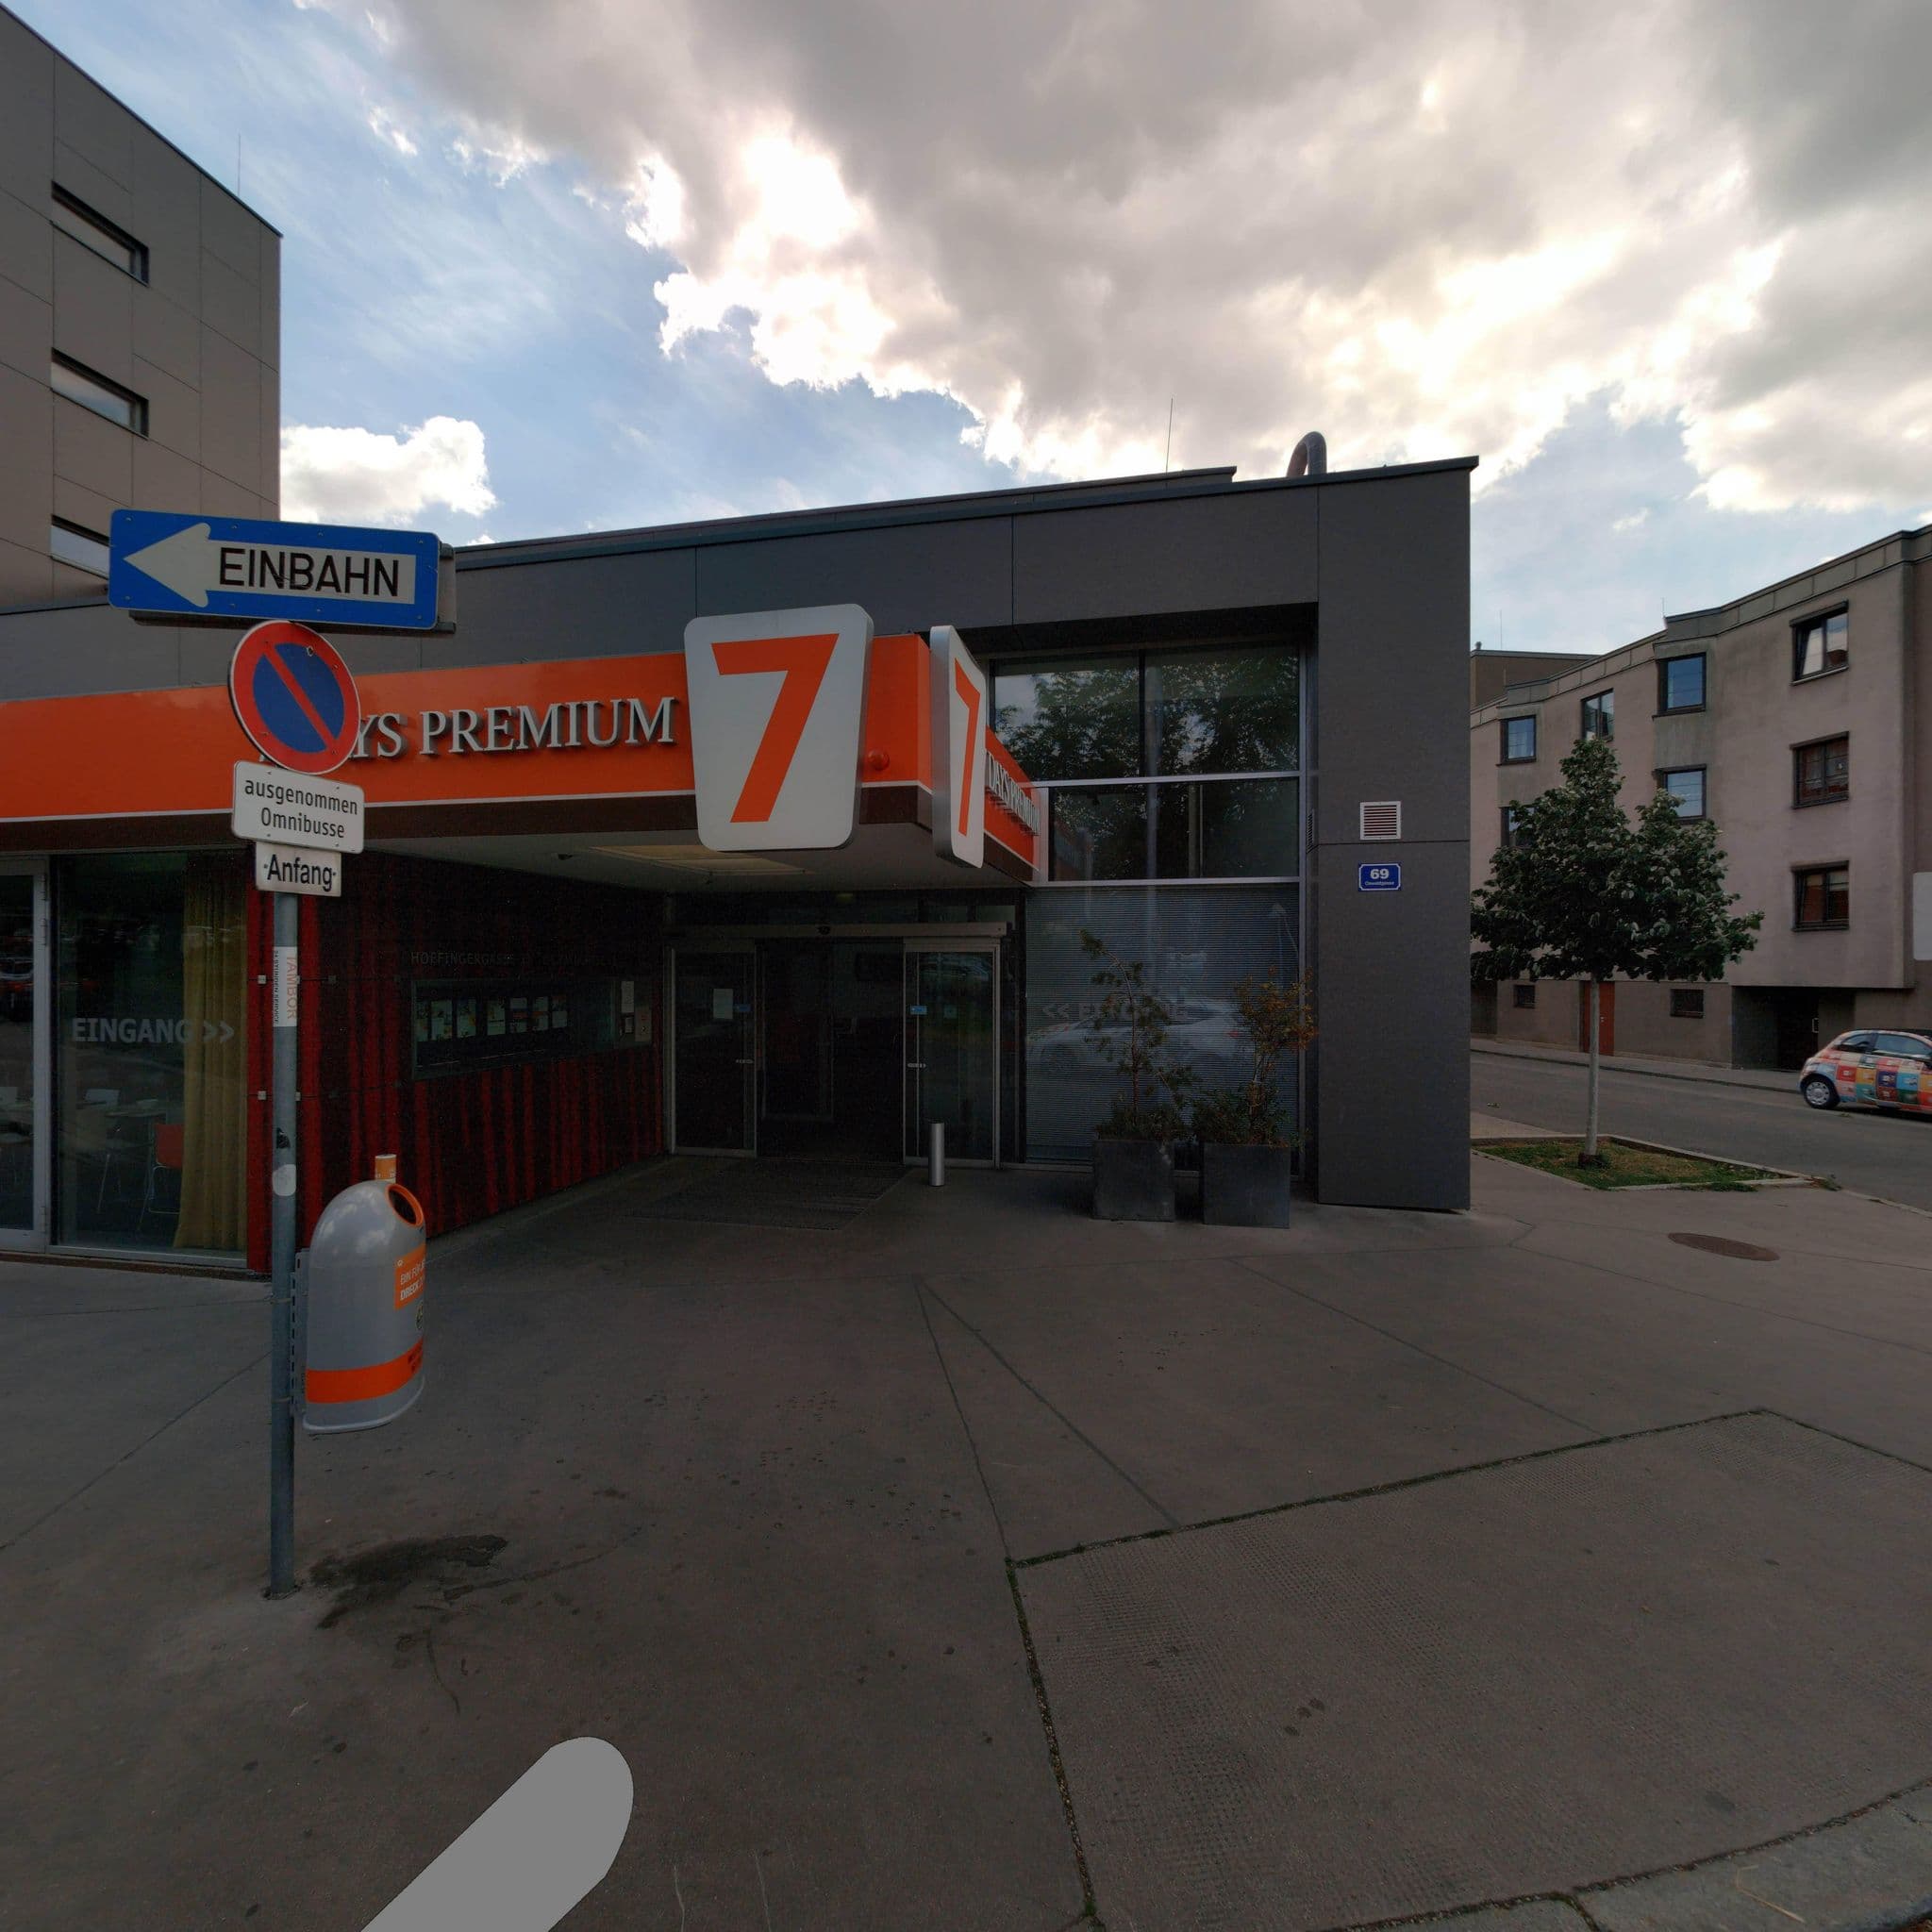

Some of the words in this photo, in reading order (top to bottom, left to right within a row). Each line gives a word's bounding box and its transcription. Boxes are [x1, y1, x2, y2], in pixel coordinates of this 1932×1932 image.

[220, 545, 400, 598] EINBAHN
[419, 696, 676, 756] PREMIUM
[710, 633, 840, 823] 7
[955, 658, 981, 837] 7
[243, 778, 359, 816] ausgenommen
[259, 808, 346, 840] Omnibusse
[1370, 868, 1390, 880] 69
[72, 1018, 194, 1043] EINGANG
